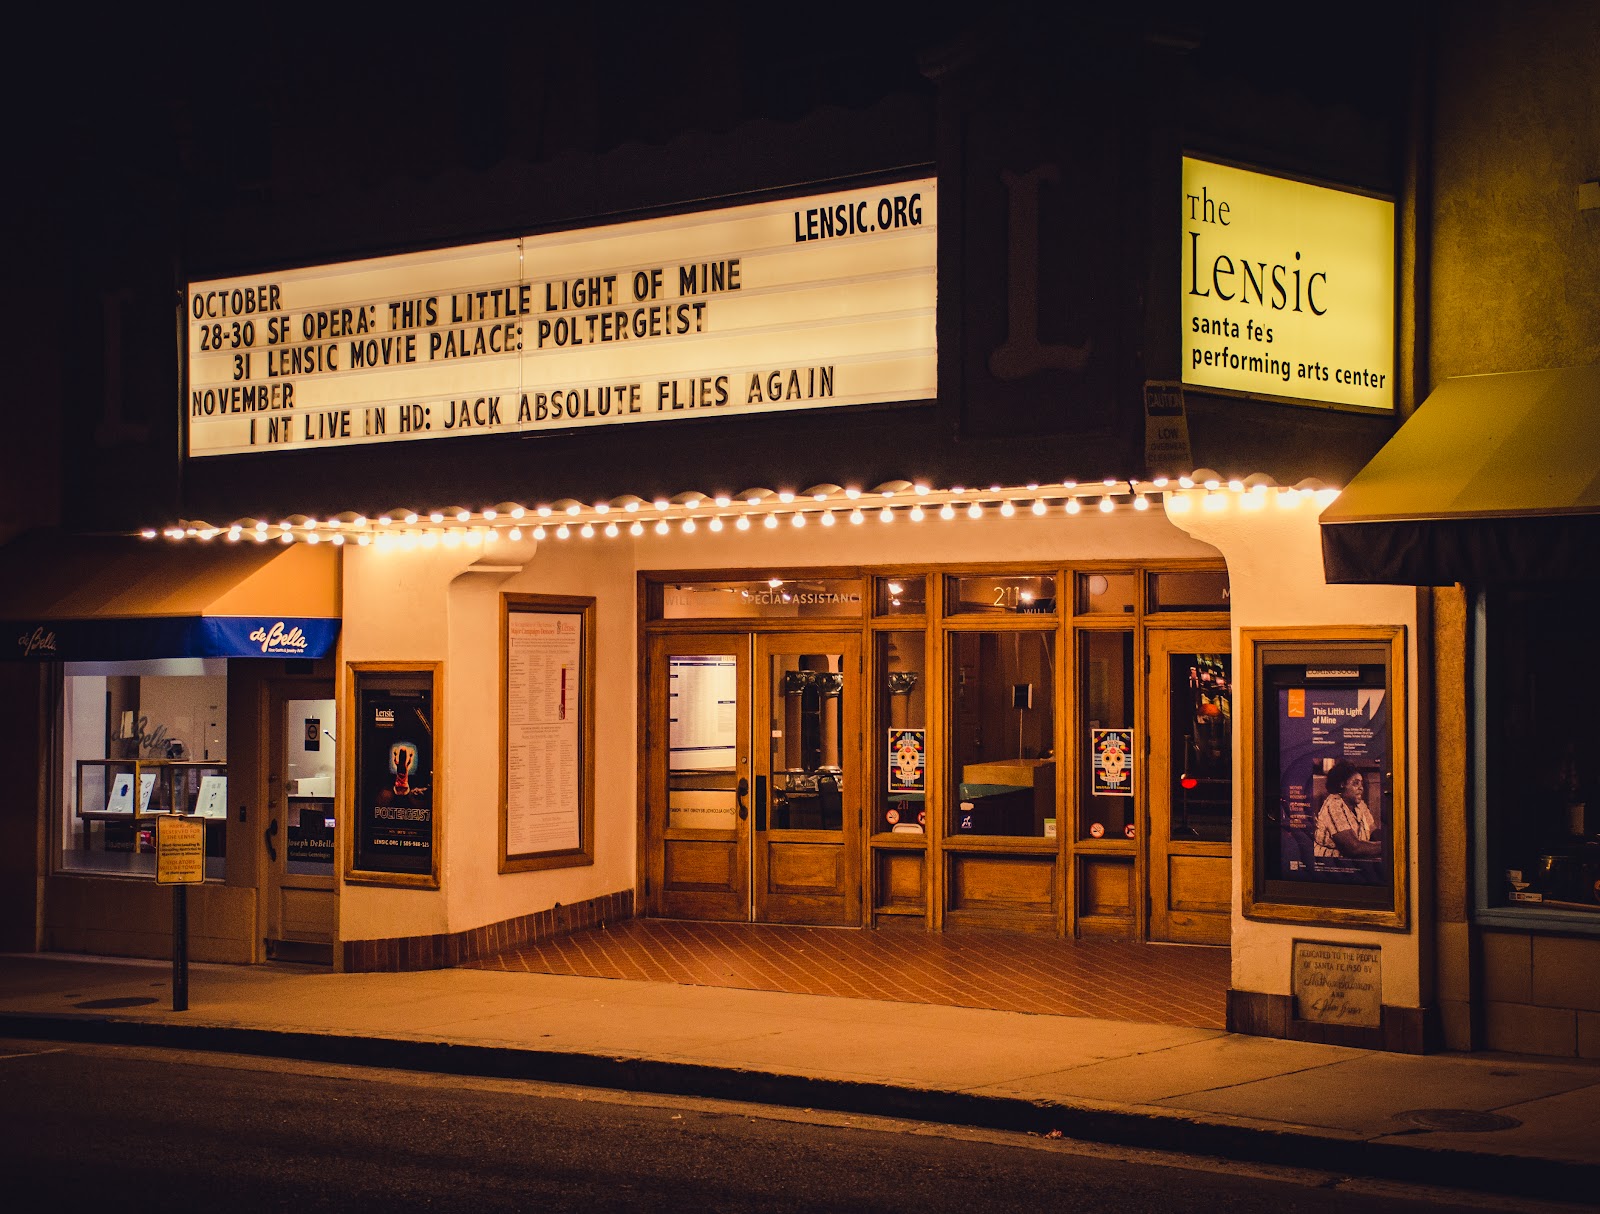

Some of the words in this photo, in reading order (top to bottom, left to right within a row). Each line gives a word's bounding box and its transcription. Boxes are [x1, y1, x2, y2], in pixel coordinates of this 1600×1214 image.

[794, 193, 922, 243] LENSIC.ORG
[1186, 186, 1231, 226] The
[192, 284, 281, 319] OCTOBER
[200, 320, 255, 351] 28-30
[267, 315, 291, 345] SF
[302, 305, 376, 337] OPERA:
[388, 297, 438, 331] THIS
[451, 285, 531, 322] LITTLE
[546, 275, 617, 312] LIGHT
[633, 269, 663, 300] OF
[679, 259, 741, 296] MINE
[267, 344, 338, 377] LENSIC
[350, 334, 416, 368] MOVIE
[429, 322, 524, 361] PALACE:
[537, 302, 707, 349] POLTERGEIST
[1192, 316, 1240, 338] santa
[1192, 346, 1291, 382] performing
[1297, 362, 1329, 382] arts
[1335, 366, 1386, 389] center
[191, 382, 294, 417] NOVEMBER
[268, 416, 292, 443] NT
[304, 410, 351, 440] LIVE
[364, 407, 386, 435] IN
[399, 404, 431, 433] HD:
[444, 396, 501, 429] JACK
[517, 383, 641, 422] ABSOLUTE
[657, 375, 729, 411] FLIES
[747, 365, 835, 404] AGAIN
[741, 594, 789, 604] SPECIAL
[993, 586, 1020, 606] 211
[1312, 707, 1327, 716] This
[1327, 707, 1345, 716] Little
[1345, 707, 1363, 718] Light
[1312, 716, 1320, 724] of
[1320, 716, 1337, 725] Mine
[374, 806, 431, 822] POLTERGEIST
[1300, 949, 1331, 959] DEDICATED
[1332, 951, 1341, 959] TO
[1343, 952, 1354, 961] THE
[1356, 953, 1378, 963] PEOPLE
[1314, 962, 1334, 970] SANTA
